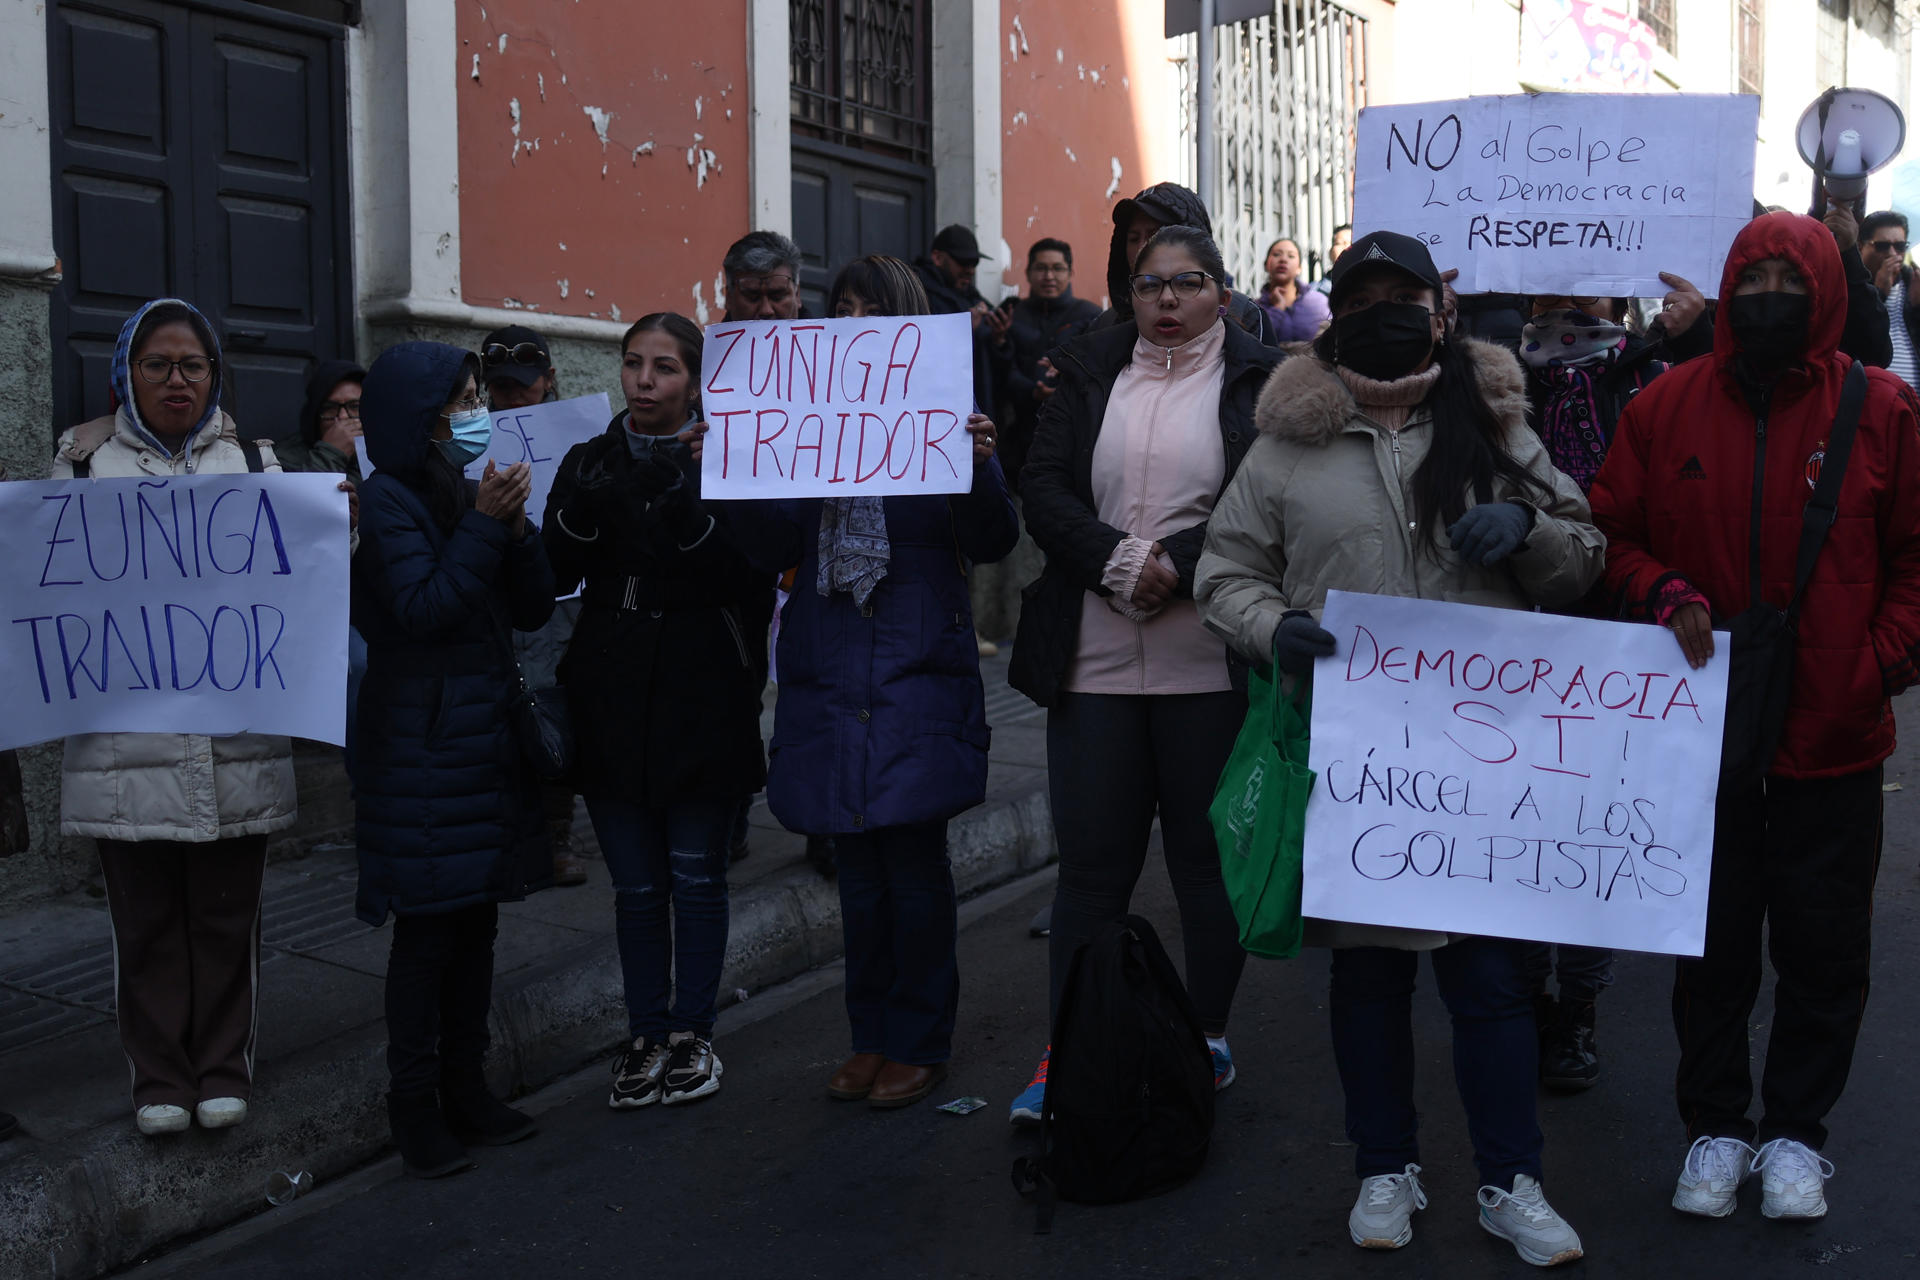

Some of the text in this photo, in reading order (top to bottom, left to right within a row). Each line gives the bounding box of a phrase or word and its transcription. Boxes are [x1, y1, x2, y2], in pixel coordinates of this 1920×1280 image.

[1386, 113, 1646, 177] NO al Golpe
[1422, 175, 1686, 208] La Democracia
[1468, 214, 1645, 251] RESPETA!!!
[706, 322, 921, 405] ZÚÑIGA
[710, 409, 959, 484] TRAIDOR
[39, 480, 292, 588] ZUÑIGA
[11, 603, 287, 704] TRAIDOR
[1345, 625, 1704, 723] DEMOCRACIA
[1326, 747, 1488, 817] CÁRCEL
[1510, 785, 1542, 820] A
[1577, 794, 1656, 848] LOS
[1351, 823, 1688, 901] GOLPISTAS
